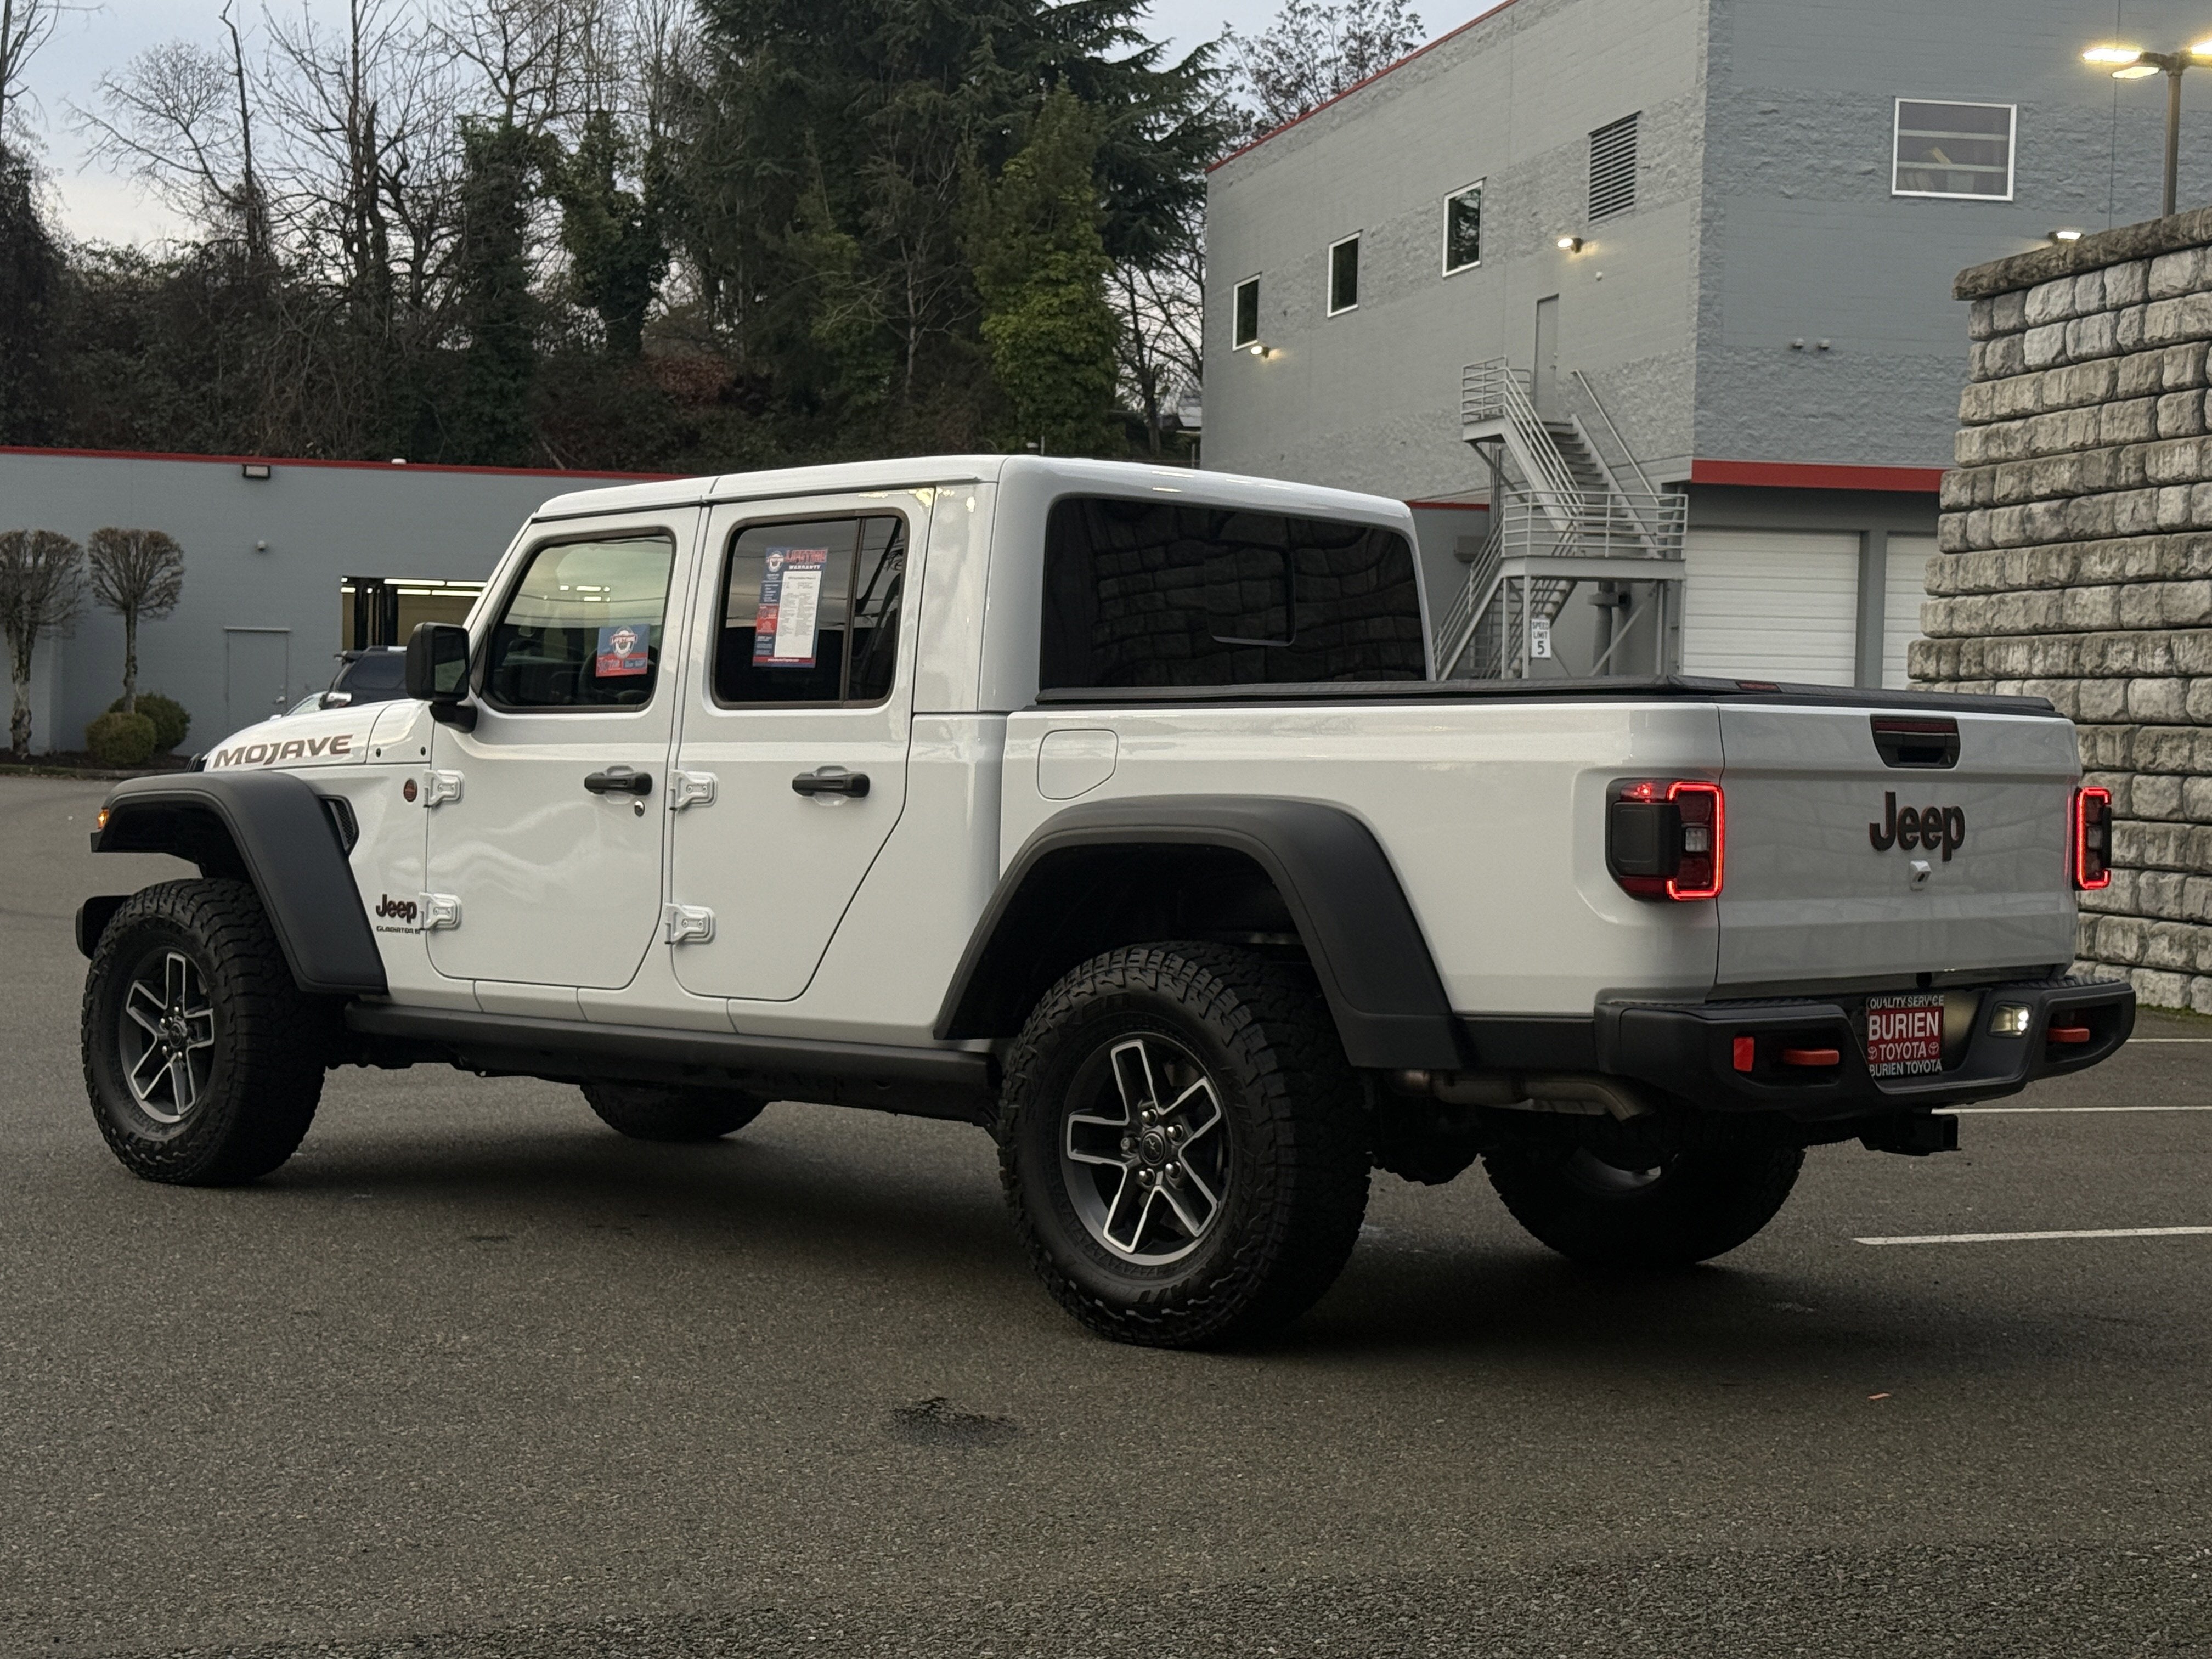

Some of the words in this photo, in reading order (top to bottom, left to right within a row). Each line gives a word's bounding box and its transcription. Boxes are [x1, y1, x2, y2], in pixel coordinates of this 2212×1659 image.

[1532, 621, 1549, 630] SPEED
[1533, 631, 1548, 639] LIMIT
[1537, 641, 1545, 655] 5
[213, 734, 354, 769] MOJAVE
[1869, 791, 1966, 862] Jeep
[376, 894, 417, 924] Jeep
[376, 926, 414, 934] GLADIATOR
[1870, 996, 1906, 1010] QUALITY
[1907, 995, 1945, 1007] SERVICE
[1869, 1011, 1939, 1041] BURIEN
[1878, 1041, 1927, 1062] TOYOTA
[1869, 1063, 1904, 1077] BURIEN
[1905, 1059, 1943, 1074] TOYOTA
